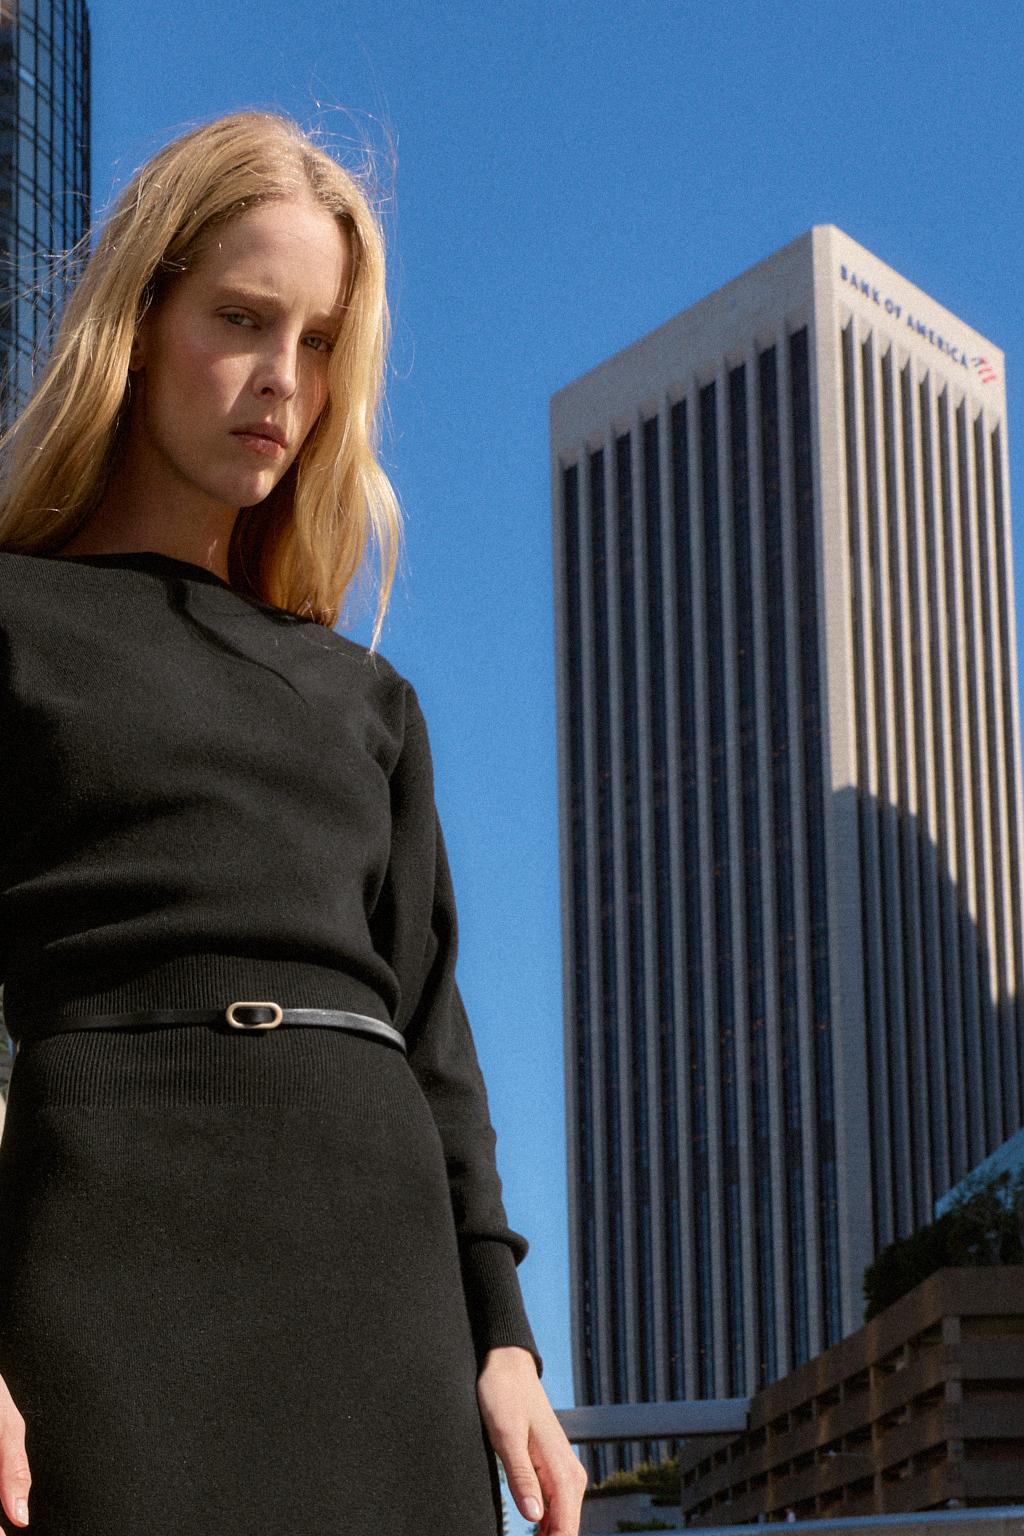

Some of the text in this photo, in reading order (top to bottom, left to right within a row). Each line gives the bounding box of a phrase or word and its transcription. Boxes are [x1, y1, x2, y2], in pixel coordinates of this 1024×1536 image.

[841, 264, 969, 370] BANK OF AMERICA
